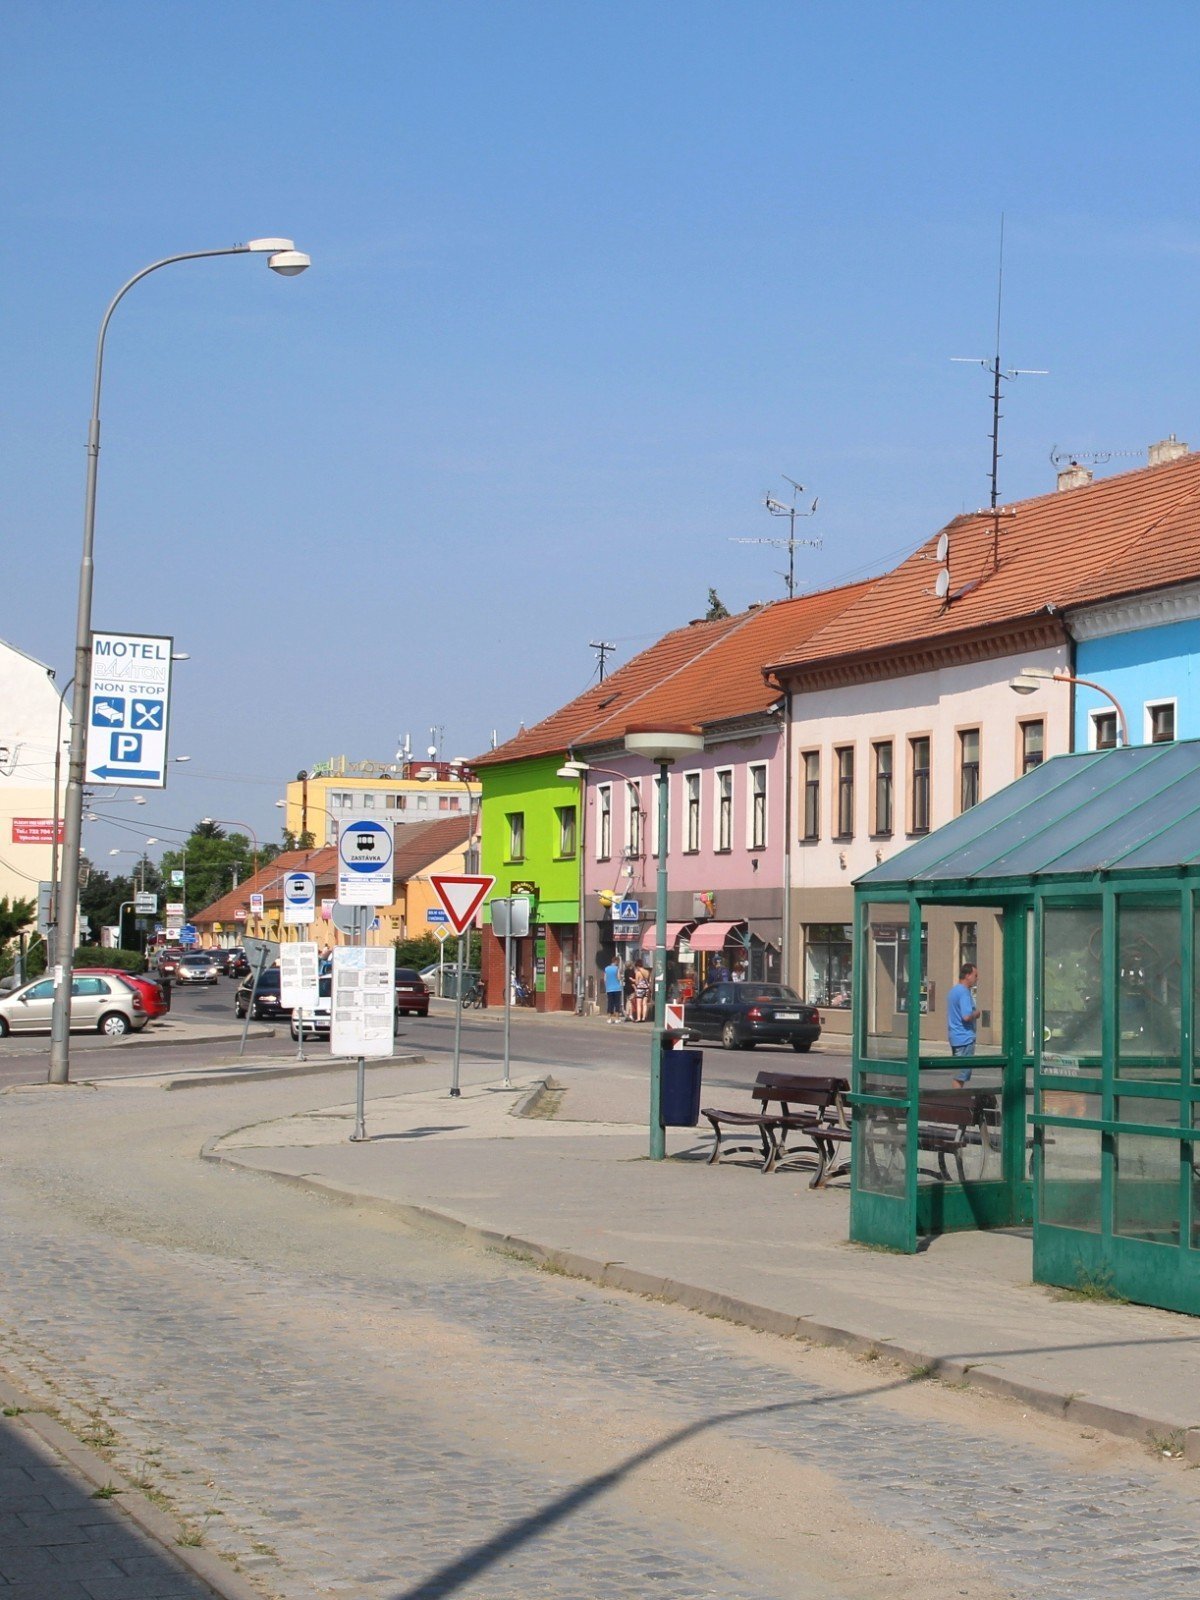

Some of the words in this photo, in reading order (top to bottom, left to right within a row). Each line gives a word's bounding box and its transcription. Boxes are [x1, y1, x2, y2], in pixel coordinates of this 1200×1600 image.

[95, 640, 166, 660] MOTEL
[94, 658, 165, 680] BALATON
[94, 682, 124, 692] NON
[129, 684, 165, 695] STOP
[117, 735, 138, 760] P
